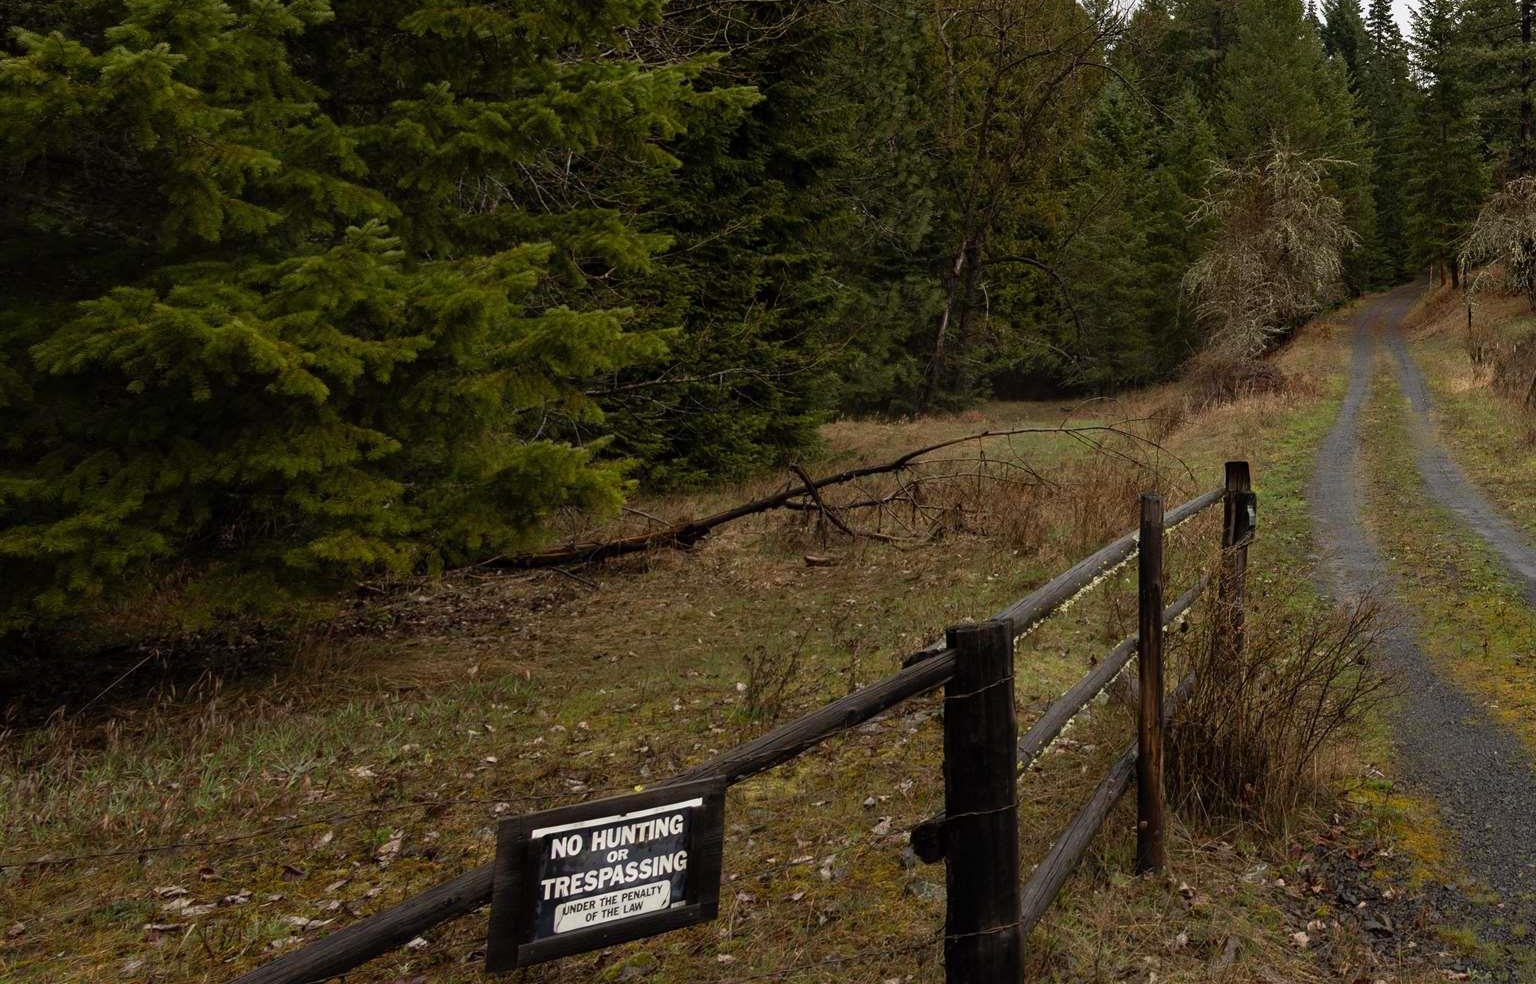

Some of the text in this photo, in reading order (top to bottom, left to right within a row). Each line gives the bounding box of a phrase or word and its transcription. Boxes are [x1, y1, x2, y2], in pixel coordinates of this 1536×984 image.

[551, 814, 684, 860] NO HUNTING
[606, 848, 629, 863] OR
[541, 851, 688, 900] TRESPASSING
[562, 884, 664, 916] UNDER THE PENALTY
[585, 901, 644, 922] OF THE LAW
